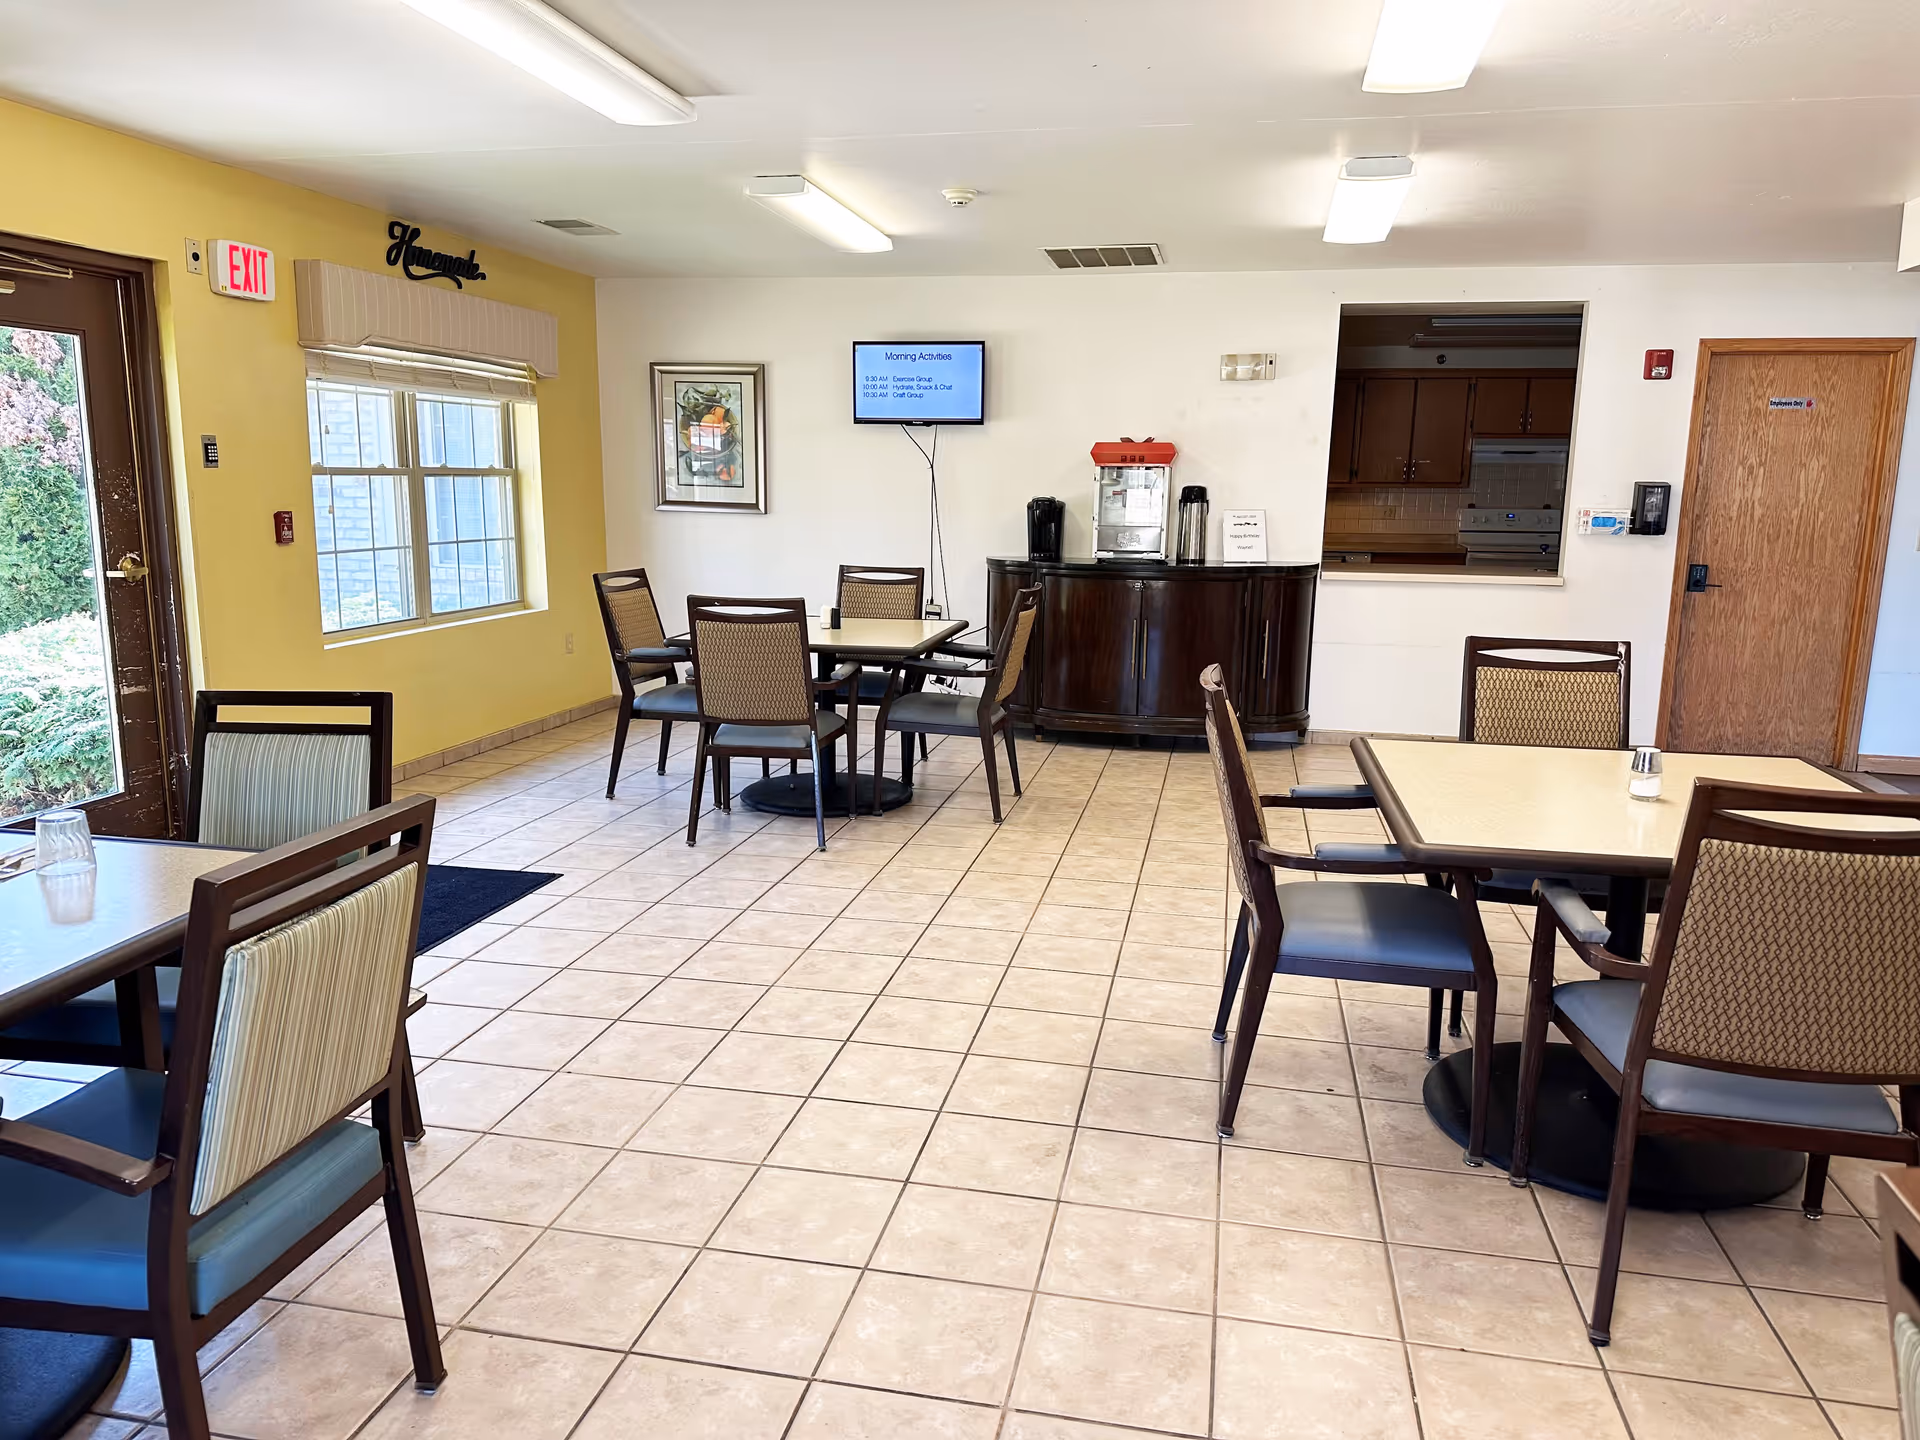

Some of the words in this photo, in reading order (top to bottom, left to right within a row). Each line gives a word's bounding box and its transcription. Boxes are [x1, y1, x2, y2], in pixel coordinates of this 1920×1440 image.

[229, 244, 268, 295] EXIT
[885, 352, 916, 362] Morning
[918, 352, 952, 360] Activities
